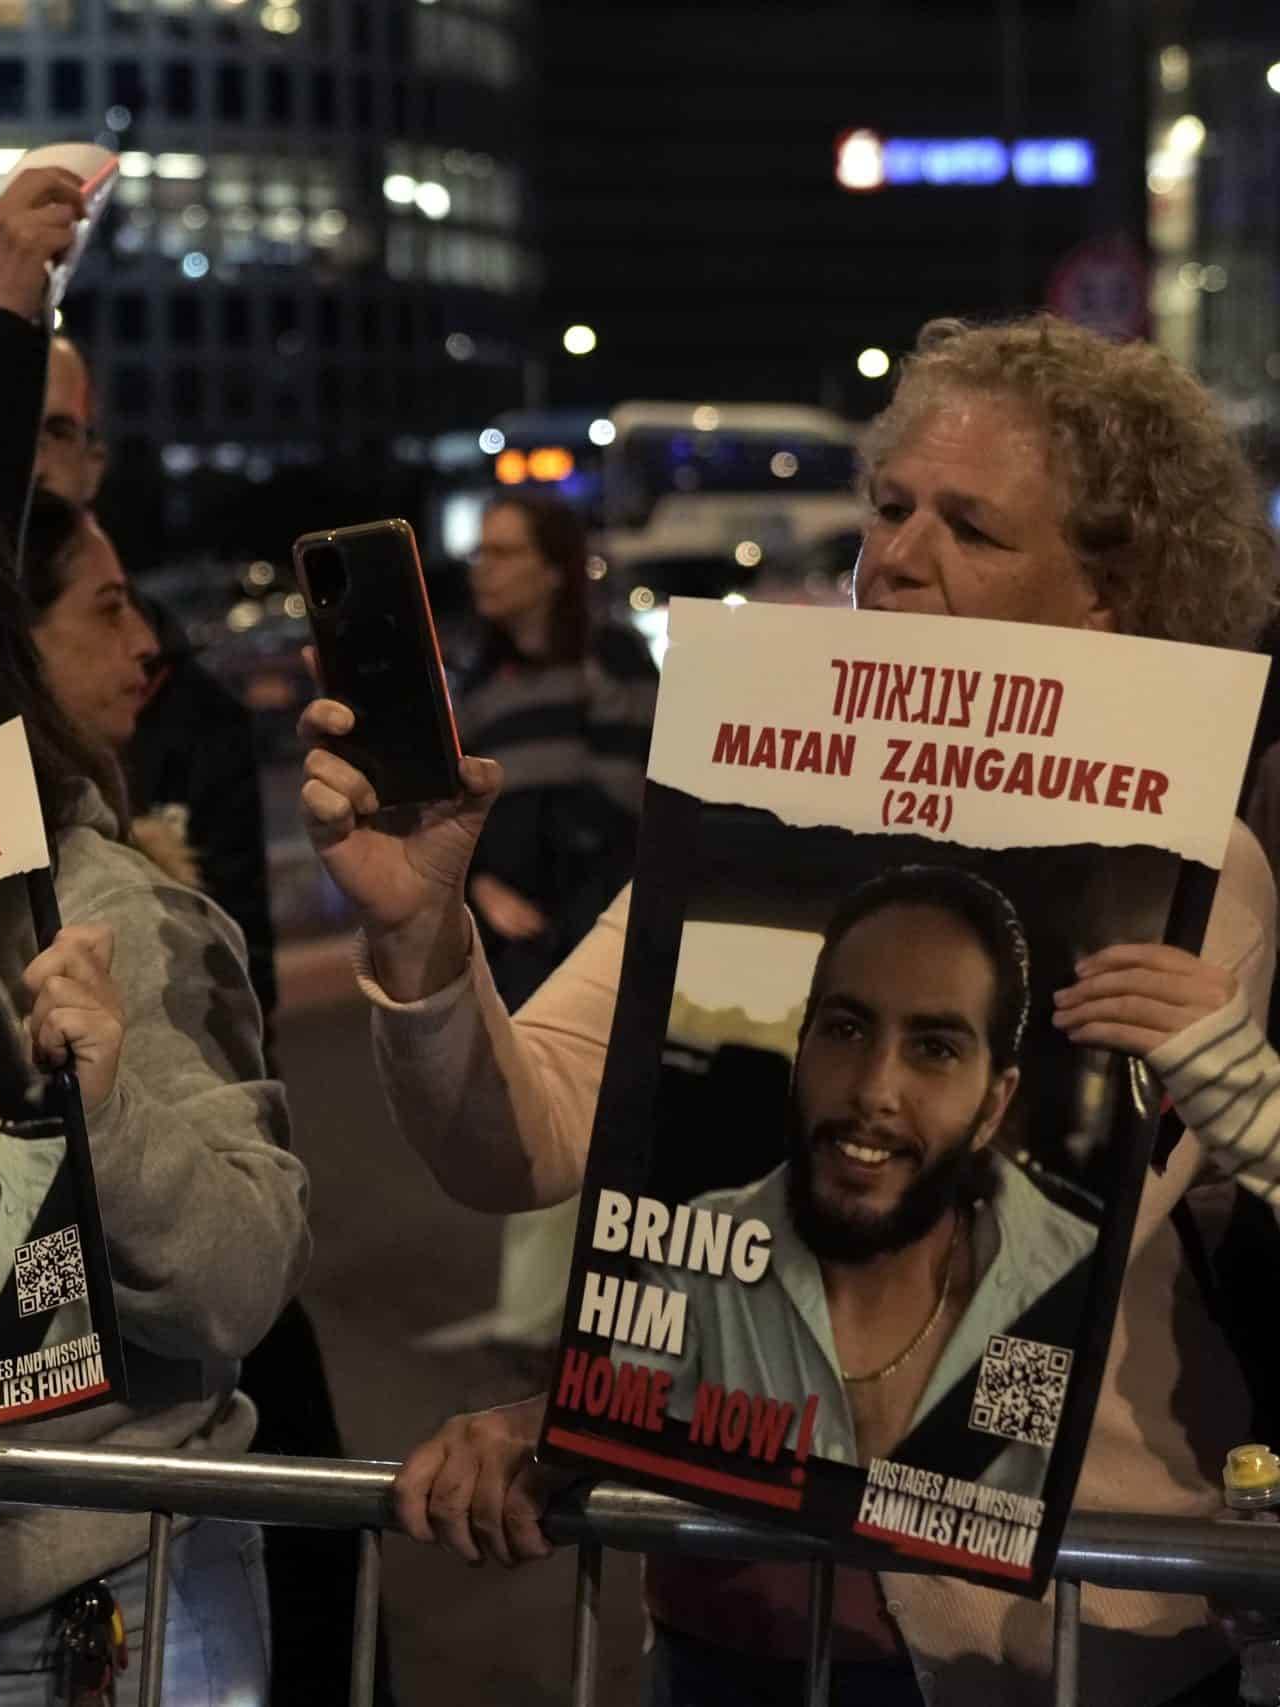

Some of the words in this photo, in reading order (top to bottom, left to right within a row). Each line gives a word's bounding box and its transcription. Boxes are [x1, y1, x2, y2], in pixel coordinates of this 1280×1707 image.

[831, 659, 981, 727] צנגאוקר
[985, 673, 1064, 738] מתן
[712, 722, 857, 777] MATAN
[879, 738, 1170, 815] ZANGAUKER
[881, 789, 954, 833] (24)
[591, 1188, 773, 1284] BRING
[578, 1271, 688, 1356] HIM
[16, 1350, 43, 1376] AND
[44, 1332, 101, 1370] MISSING
[38, 1354, 105, 1400] FORUM
[556, 1349, 671, 1433] HOME
[858, 1487, 956, 1546] FAMILIES
[955, 1511, 1038, 1568] FORUM
[867, 1456, 944, 1502] HOSTAGES
[941, 1477, 976, 1508] AND
[974, 1485, 1046, 1528] MISSING
